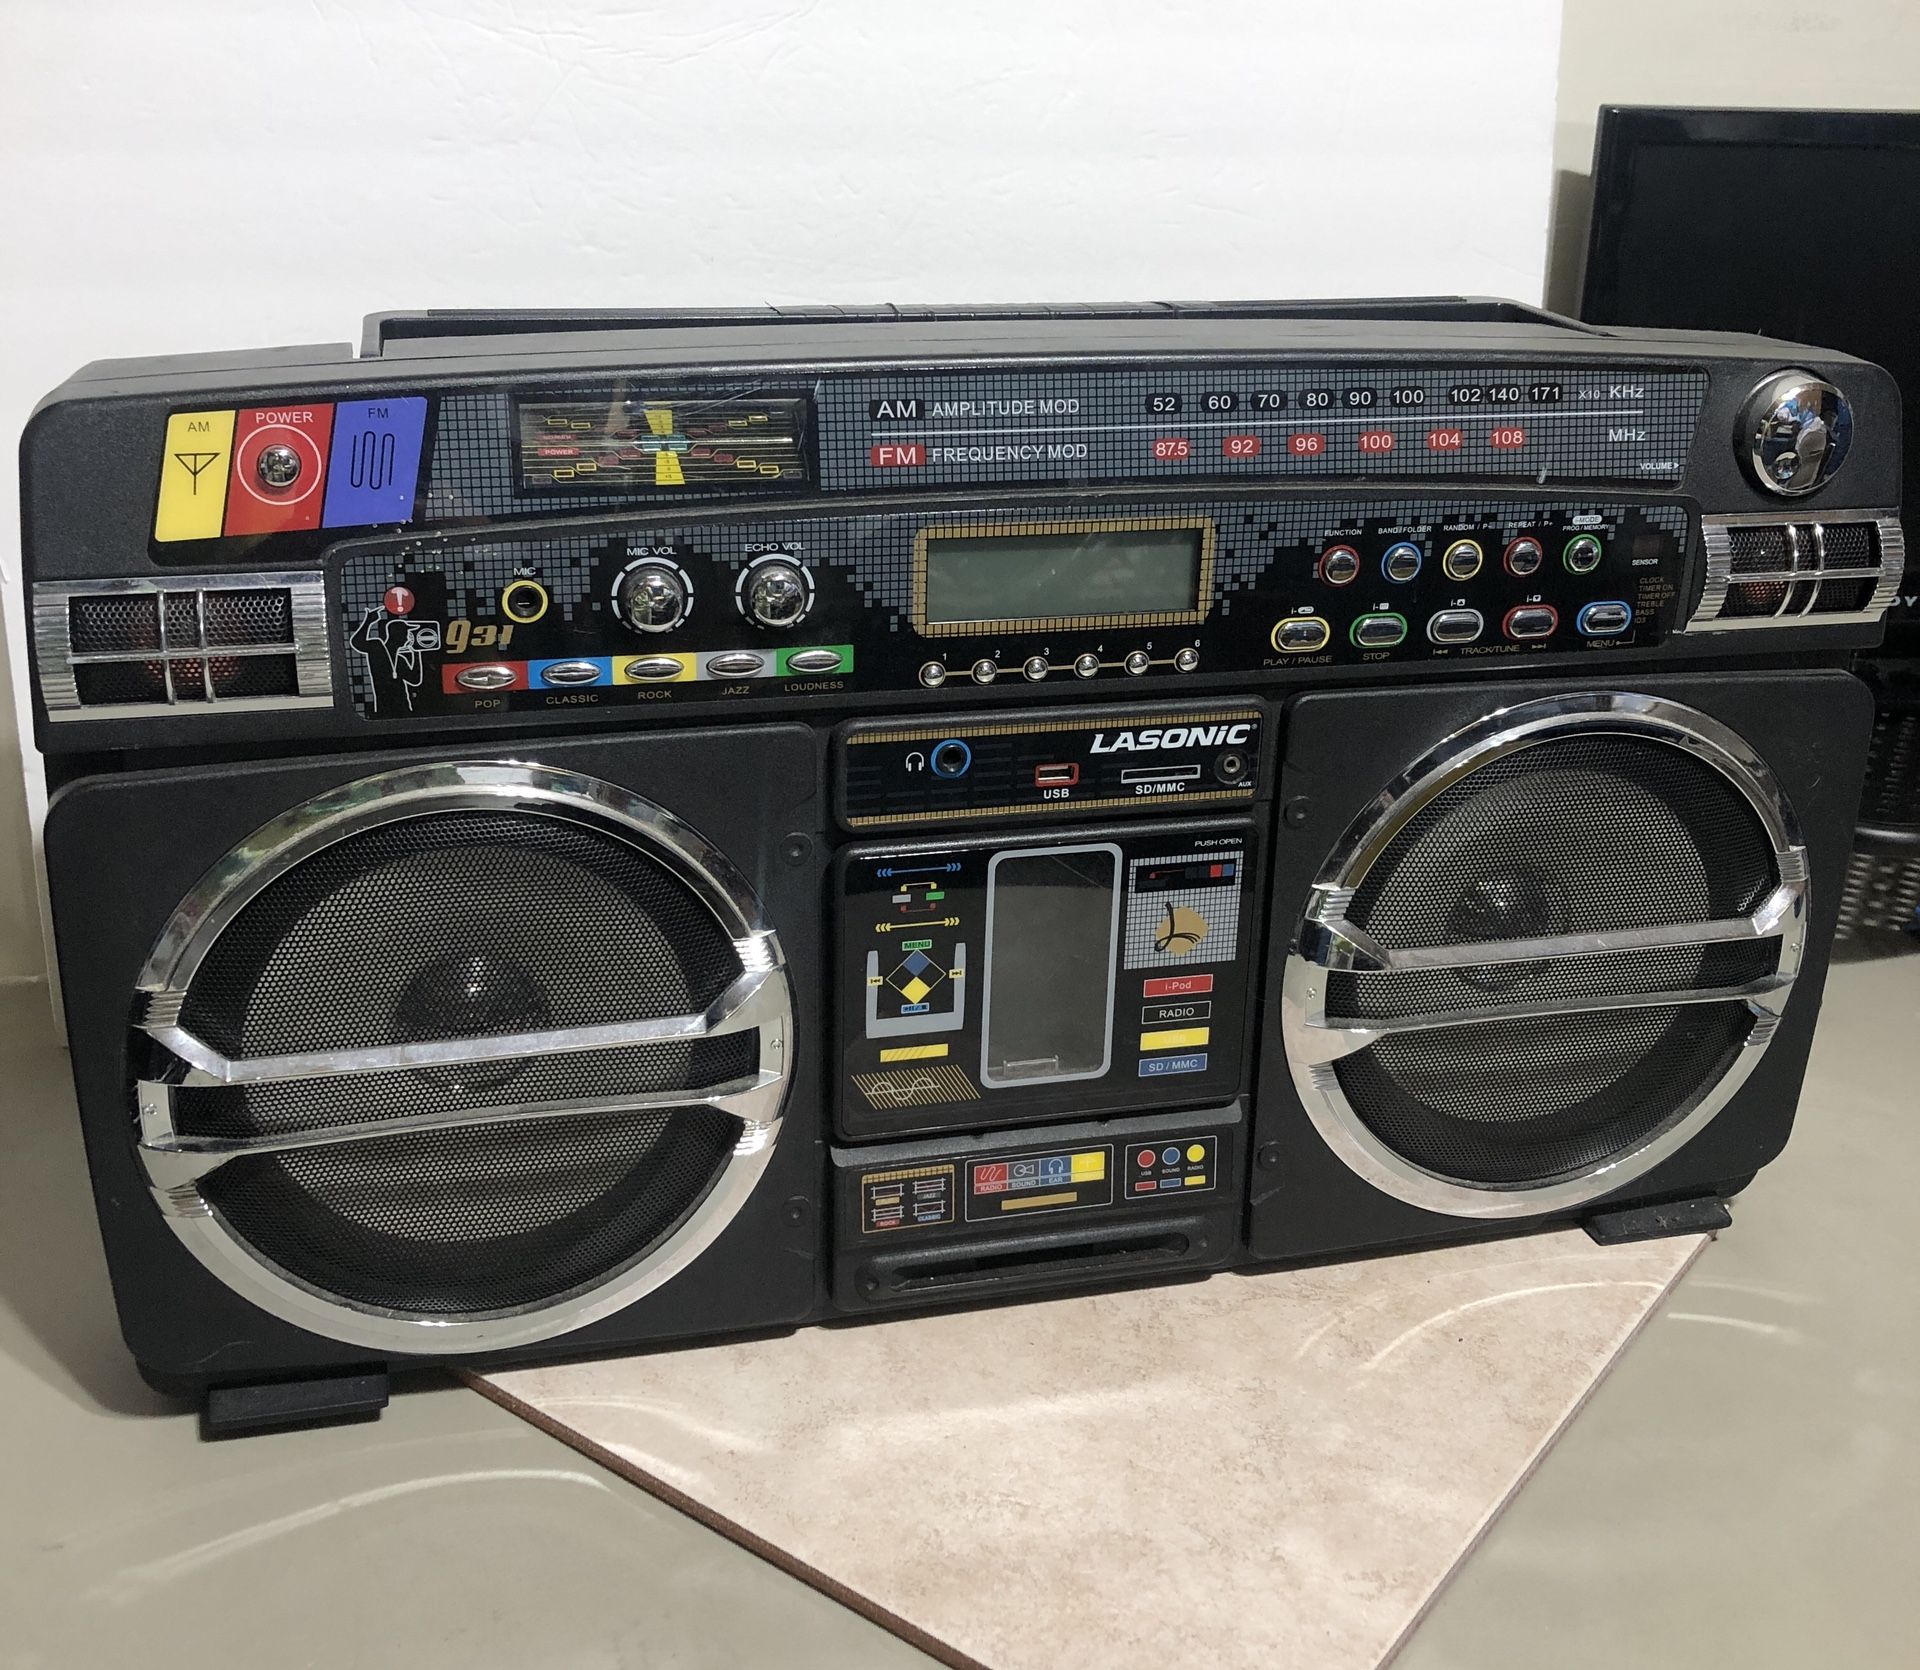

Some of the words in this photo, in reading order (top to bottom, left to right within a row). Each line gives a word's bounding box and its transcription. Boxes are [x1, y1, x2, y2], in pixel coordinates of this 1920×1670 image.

[1393, 390, 1424, 404] 100
[1451, 388, 1481, 402] 102
[1488, 387, 1520, 401] 140
[1531, 386, 1560, 400] 171
[1578, 389, 1600, 399] X10
[1609, 385, 1644, 399] KHz
[1208, 395, 1231, 410] 60
[1257, 394, 1280, 408] 70
[1306, 392, 1329, 407] 80
[1349, 391, 1372, 405] 90
[876, 400, 917, 418] AM
[932, 400, 1035, 416] AMPLITUDE
[1039, 399, 1080, 414] MOD
[1152, 397, 1176, 412] 52
[255, 411, 314, 424] POWER
[367, 407, 390, 419] FM
[187, 421, 210, 433] AM
[1429, 433, 1460, 447] 104
[1492, 431, 1523, 445] 108
[1608, 429, 1647, 442] MHz
[1231, 439, 1254, 454] 92
[1295, 437, 1318, 452] 96
[1360, 435, 1392, 449] 100
[1155, 441, 1188, 456] 87.5
[879, 447, 916, 465] FM
[932, 446, 1043, 462] FREQUENCY
[1048, 444, 1088, 459] MOD
[1640, 462, 1673, 470] VOLUME
[1443, 523, 1475, 531] RANDOM
[1508, 520, 1537, 528] REPEAT
[1324, 529, 1363, 537] FUNCTION
[626, 547, 649, 556] MIC
[652, 546, 677, 555] VOL
[744, 542, 779, 553] ECHO
[782, 541, 806, 551] VOL
[1631, 558, 1658, 566] SENSOR
[513, 567, 536, 576] MIC
[1097, 644, 1103, 652] 4
[1146, 642, 1152, 650] 5
[1194, 639, 1201, 647] 6
[1586, 640, 1616, 648] MENU
[942, 652, 948, 661] 1
[994, 650, 1001, 658] 2
[1043, 647, 1050, 656] 3
[1362, 652, 1391, 661] STOP
[1263, 657, 1289, 666] PLAY
[1298, 655, 1333, 664] PAUSE
[721, 686, 750, 696] JAZZ
[784, 680, 844, 692] LOUDNESS
[546, 694, 599, 705] CLASSIC
[637, 690, 673, 700] ROCK
[474, 699, 501, 709] POP
[1135, 782, 1185, 795] SD/MMC
[1238, 780, 1252, 788] AUX
[1043, 788, 1070, 799] USB
[1194, 839, 1218, 848] PUSH
[1219, 838, 1243, 846] OPEN
[1165, 980, 1192, 990] i-Pod
[1159, 1007, 1195, 1019] RADIO
[1148, 1062, 1164, 1072] SD
[1171, 1058, 1198, 1069] MMC
[1011, 1179, 1036, 1189] SOUND
[1048, 1176, 1063, 1184] EAR
[980, 1184, 1003, 1193] RADIO
